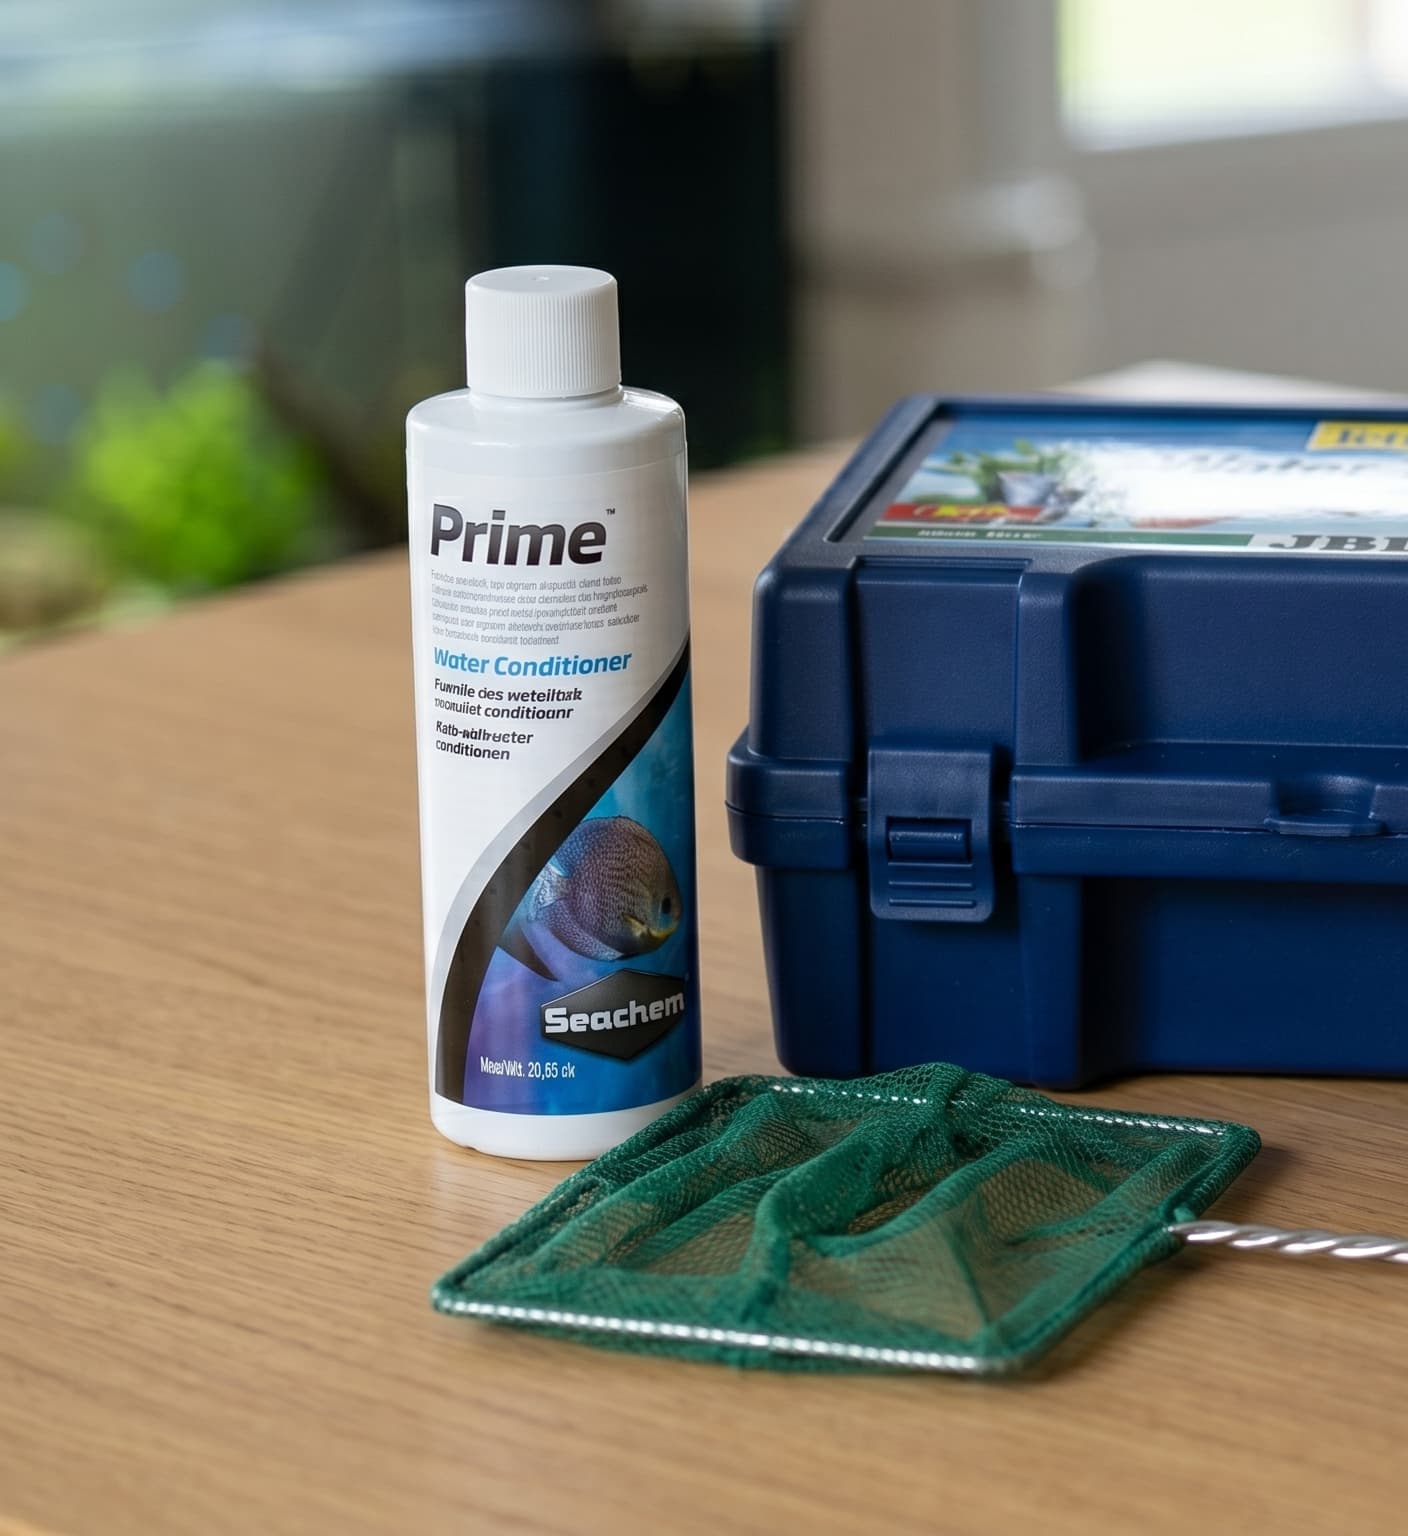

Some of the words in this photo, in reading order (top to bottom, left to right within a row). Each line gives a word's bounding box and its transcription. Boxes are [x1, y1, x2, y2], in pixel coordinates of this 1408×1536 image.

[430, 503, 607, 565] Prime
[434, 647, 490, 674] Water
[494, 651, 633, 677] Conditioner
[545, 992, 685, 1034] Seachem
